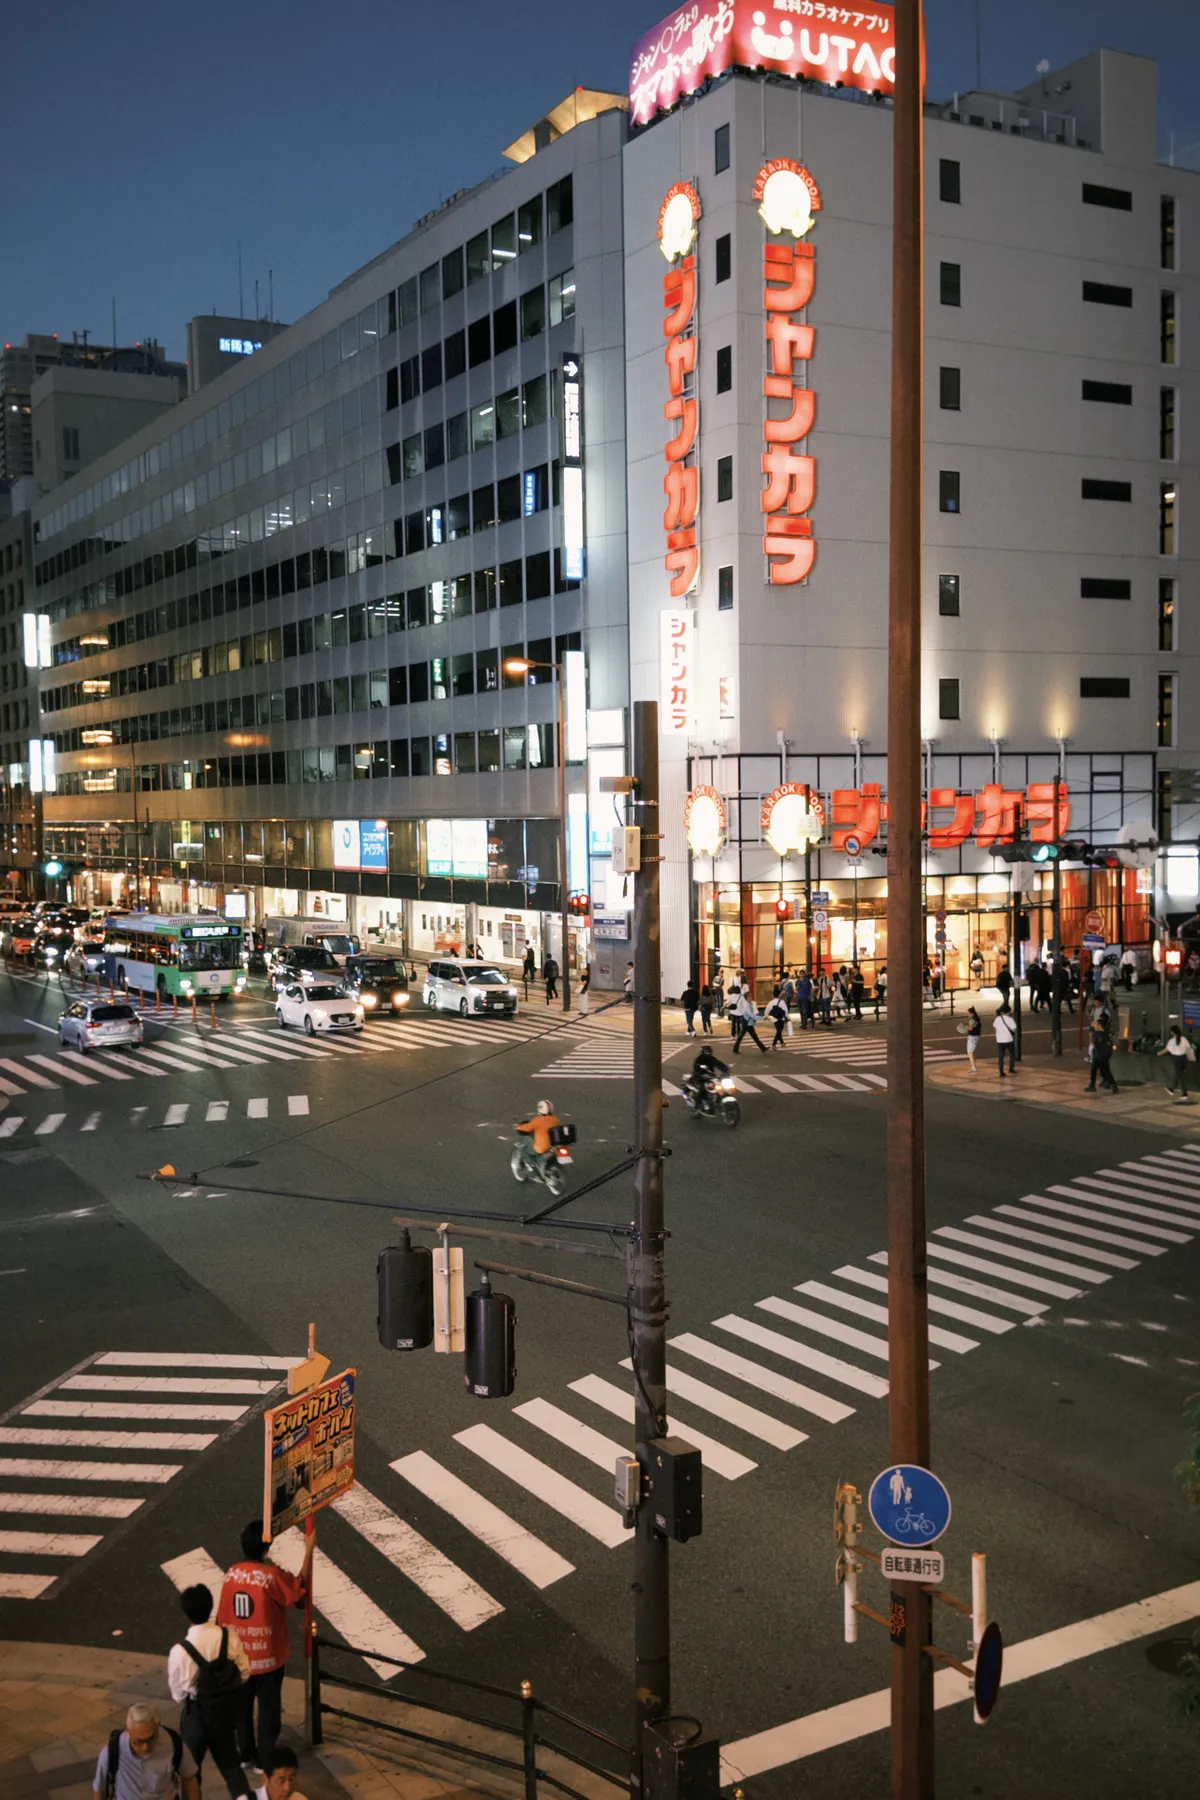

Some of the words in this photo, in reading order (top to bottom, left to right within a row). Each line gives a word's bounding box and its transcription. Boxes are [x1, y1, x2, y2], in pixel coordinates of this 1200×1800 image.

[663, 254, 698, 597] ジャンカラ
[761, 240, 816, 585] ジャンカラ
[832, 783, 1070, 851] ジンカラ
[273, 1389, 341, 1441] ネットカフェ
[885, 1556, 940, 1574] 自転車通行可
